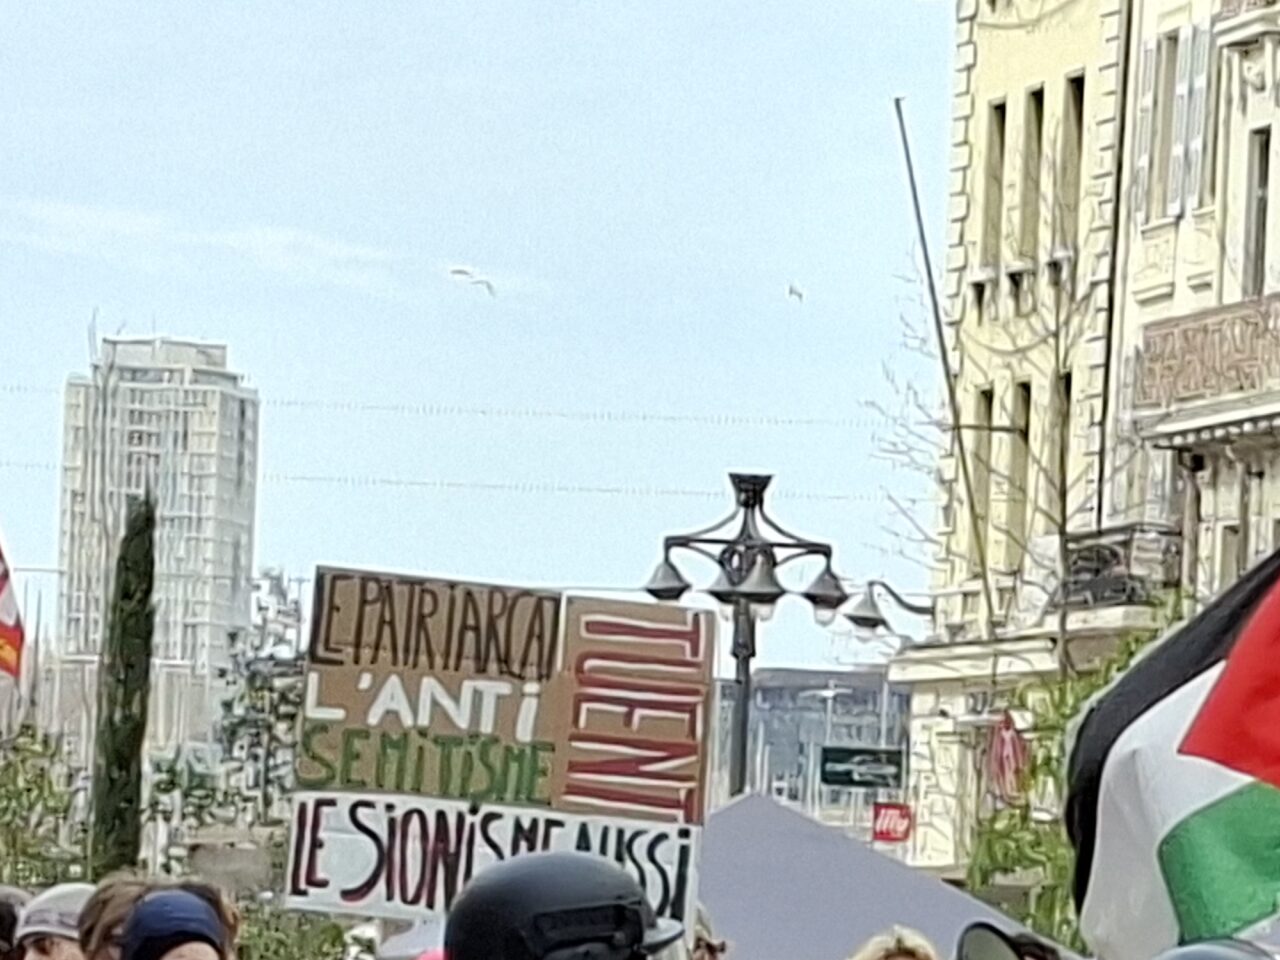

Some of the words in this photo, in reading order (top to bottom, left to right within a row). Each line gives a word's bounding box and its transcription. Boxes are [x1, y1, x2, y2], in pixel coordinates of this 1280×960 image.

[309, 573, 353, 666] LE
[561, 608, 706, 826] TUENT
[289, 799, 338, 897] LE
